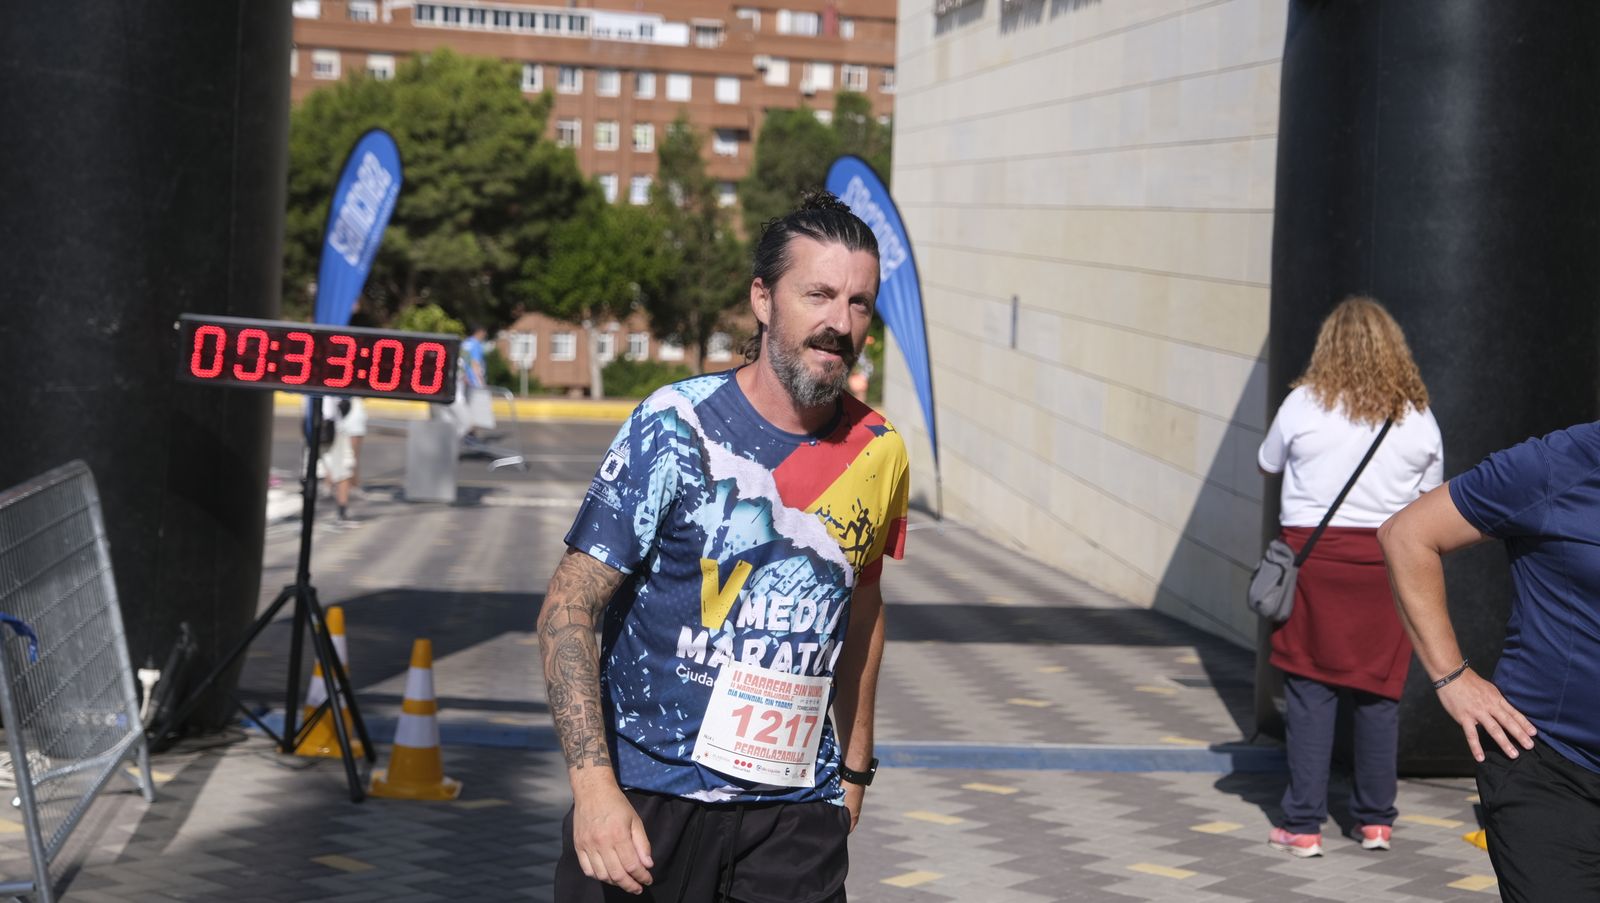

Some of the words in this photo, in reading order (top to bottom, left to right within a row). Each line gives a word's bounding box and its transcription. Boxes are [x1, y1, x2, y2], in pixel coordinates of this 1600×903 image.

[190, 325, 446, 395] 00:33:00
[700, 558, 753, 630] V
[675, 664, 717, 687] Ciuda
[743, 673, 792, 695] CARRERA
[793, 684, 808, 697] SIN
[738, 691, 764, 704] MUNDIAL
[731, 704, 818, 748] 1217
